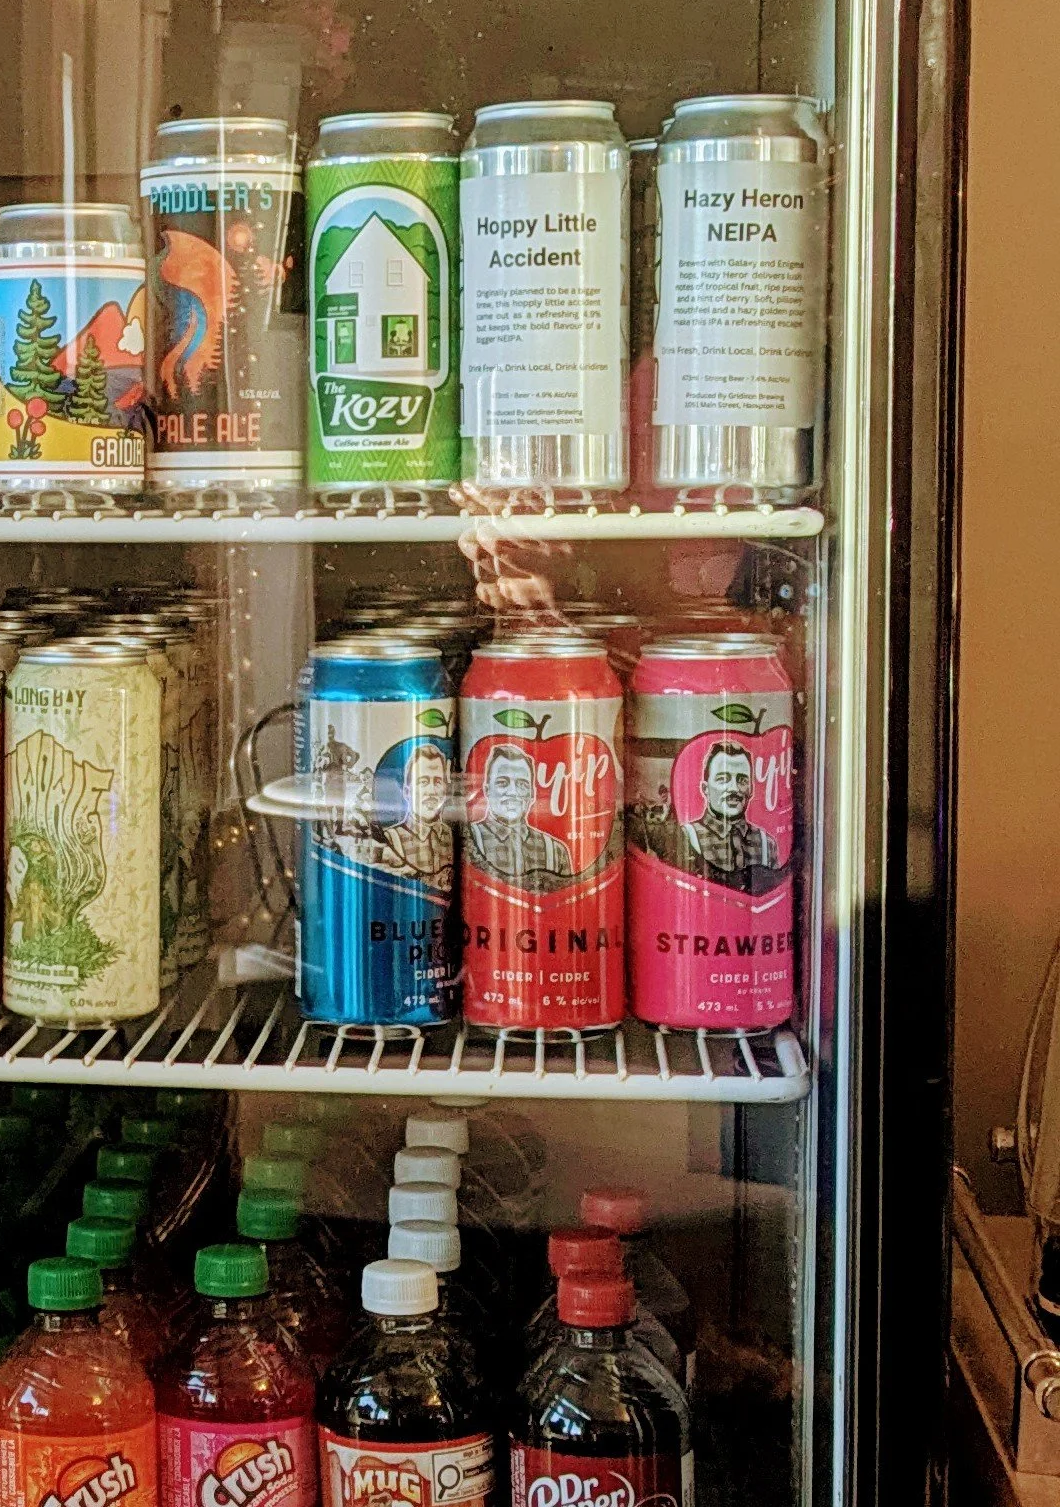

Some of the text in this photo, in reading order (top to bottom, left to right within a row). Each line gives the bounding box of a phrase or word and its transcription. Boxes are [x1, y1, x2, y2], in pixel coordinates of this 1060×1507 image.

[150, 181, 273, 215] PADDLER'S
[684, 188, 804, 212] Hazy Heron
[477, 213, 597, 238] Hoppy Little
[708, 223, 777, 242] NEIPA
[489, 247, 581, 268] Accident
[702, 347, 726, 355] Drink
[555, 363, 576, 371] Drink
[323, 382, 346, 395] The
[330, 394, 424, 431] Kozy
[157, 413, 261, 443] PALE ALE
[15, 686, 49, 707] LONG
[538, 734, 608, 817] yip
[493, 970, 590, 982] CIDER CIDRE
[710, 973, 750, 983] CIDER
[404, 996, 425, 1006] 473
[483, 992, 504, 1003] 473
[698, 1002, 721, 1011] 473
[353, 1469, 421, 1504] MUG
[559, 1473, 599, 1505] Dr
